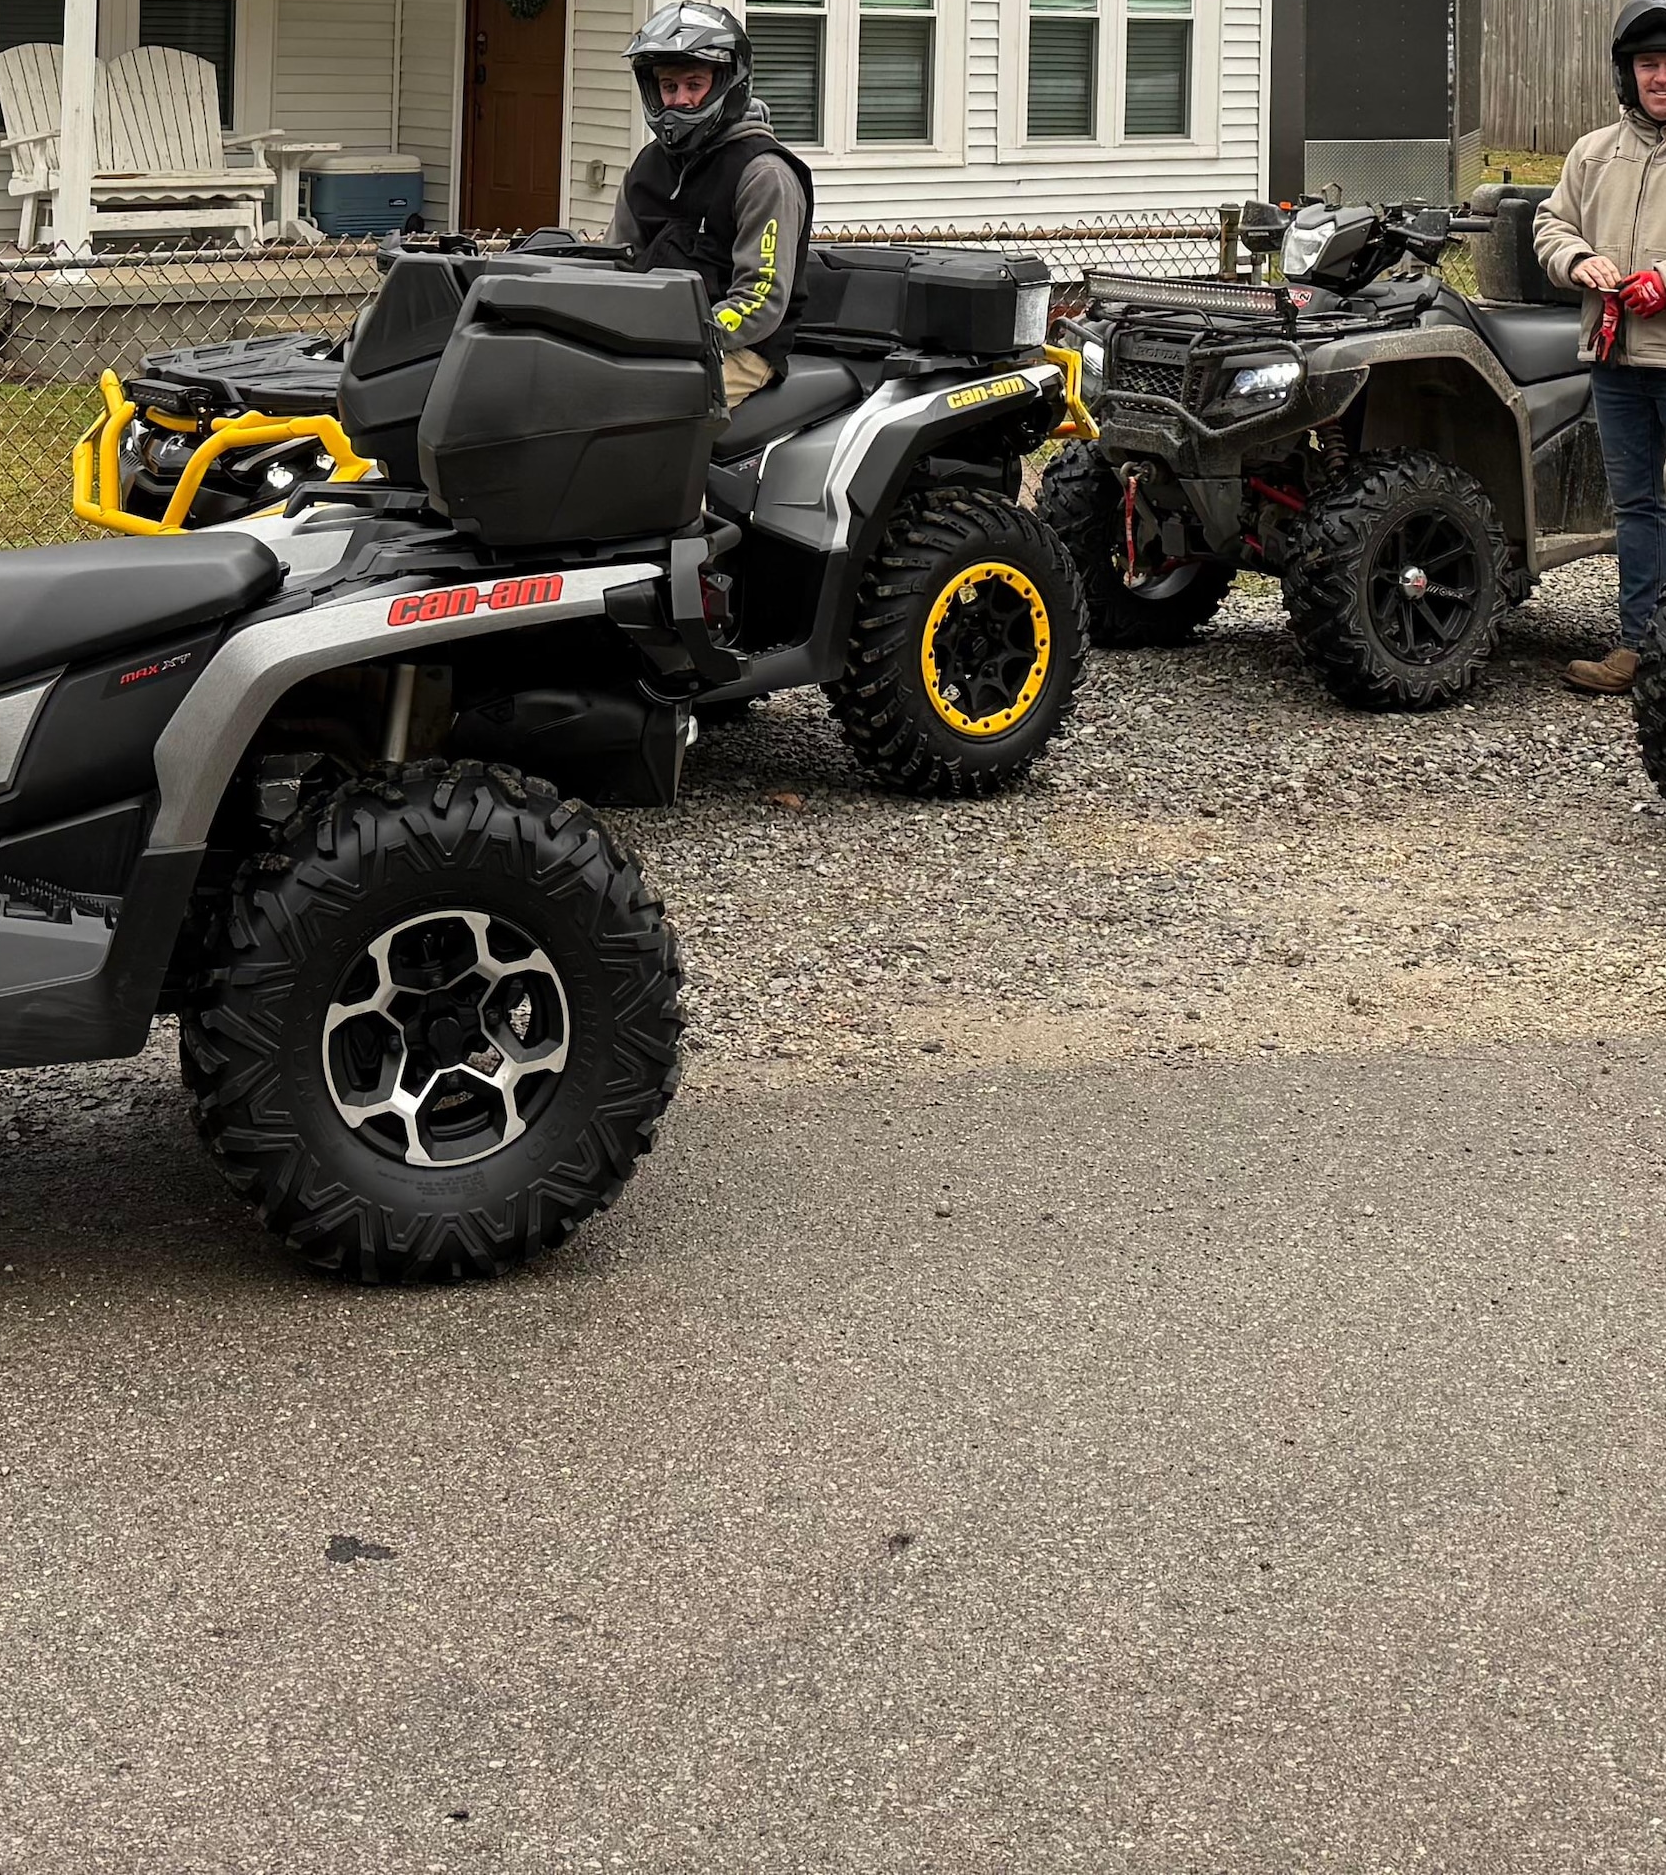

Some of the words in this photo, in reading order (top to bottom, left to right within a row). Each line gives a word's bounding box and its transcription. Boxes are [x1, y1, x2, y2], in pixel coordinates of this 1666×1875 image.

[946, 376, 1026, 409] can-am
[387, 574, 564, 627] can-am
[120, 663, 159, 684] MAX
